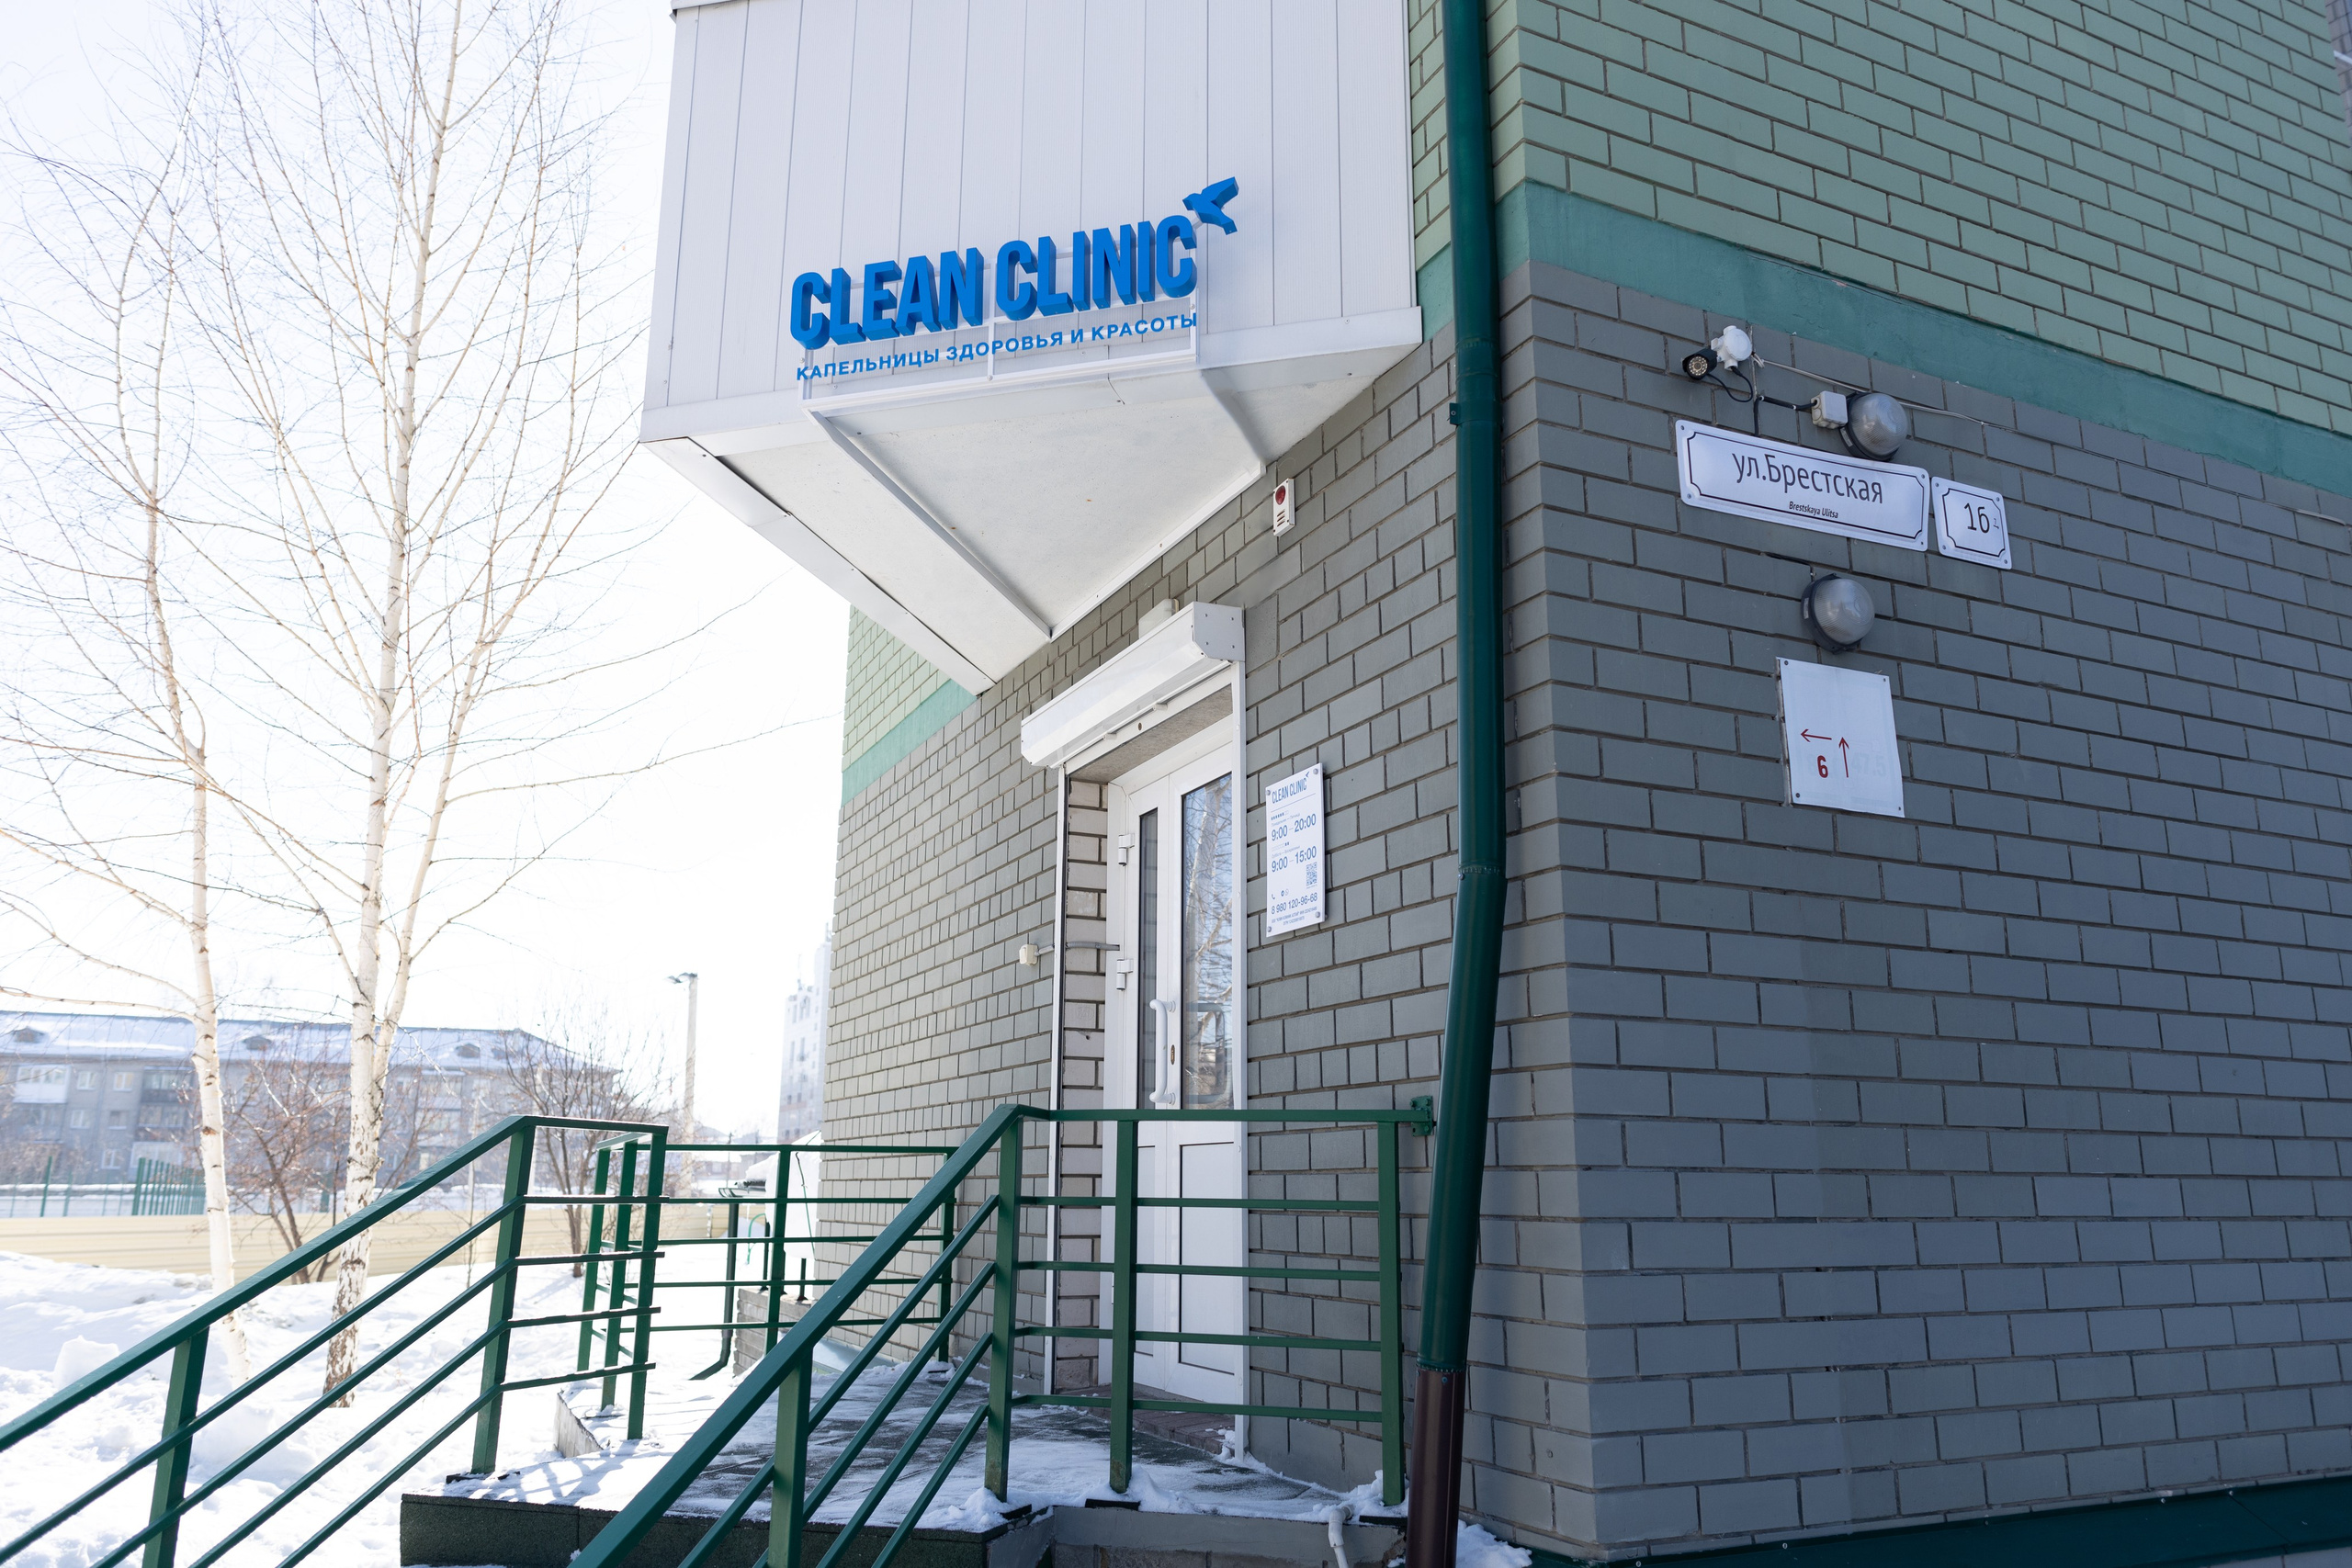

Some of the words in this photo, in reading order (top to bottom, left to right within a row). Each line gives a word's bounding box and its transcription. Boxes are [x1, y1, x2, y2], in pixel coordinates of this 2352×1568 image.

[790, 247, 984, 350] CLEAN
[995, 214, 1198, 321] CLINIC
[796, 347, 940, 381] КАПЕЛЬНИЦЫ
[945, 332, 1063, 362] ЗДОРОВЬЯ
[1070, 328, 1085, 344] И
[1091, 312, 1198, 340] КРАСОТЫ
[1731, 452, 1884, 505] ул.Брестская
[1789, 501, 1821, 516] Brestskaya
[1822, 508, 1839, 520] Ulitsa
[1816, 755, 1828, 778] 6
[1272, 785, 1289, 804] CLEAN
[1289, 778, 1307, 796] CLINIC
[1272, 825, 1288, 841] 9:00
[1294, 813, 1317, 832] 20:00
[1272, 856, 1288, 873] 9:00
[1295, 845, 1317, 864] 15:00
